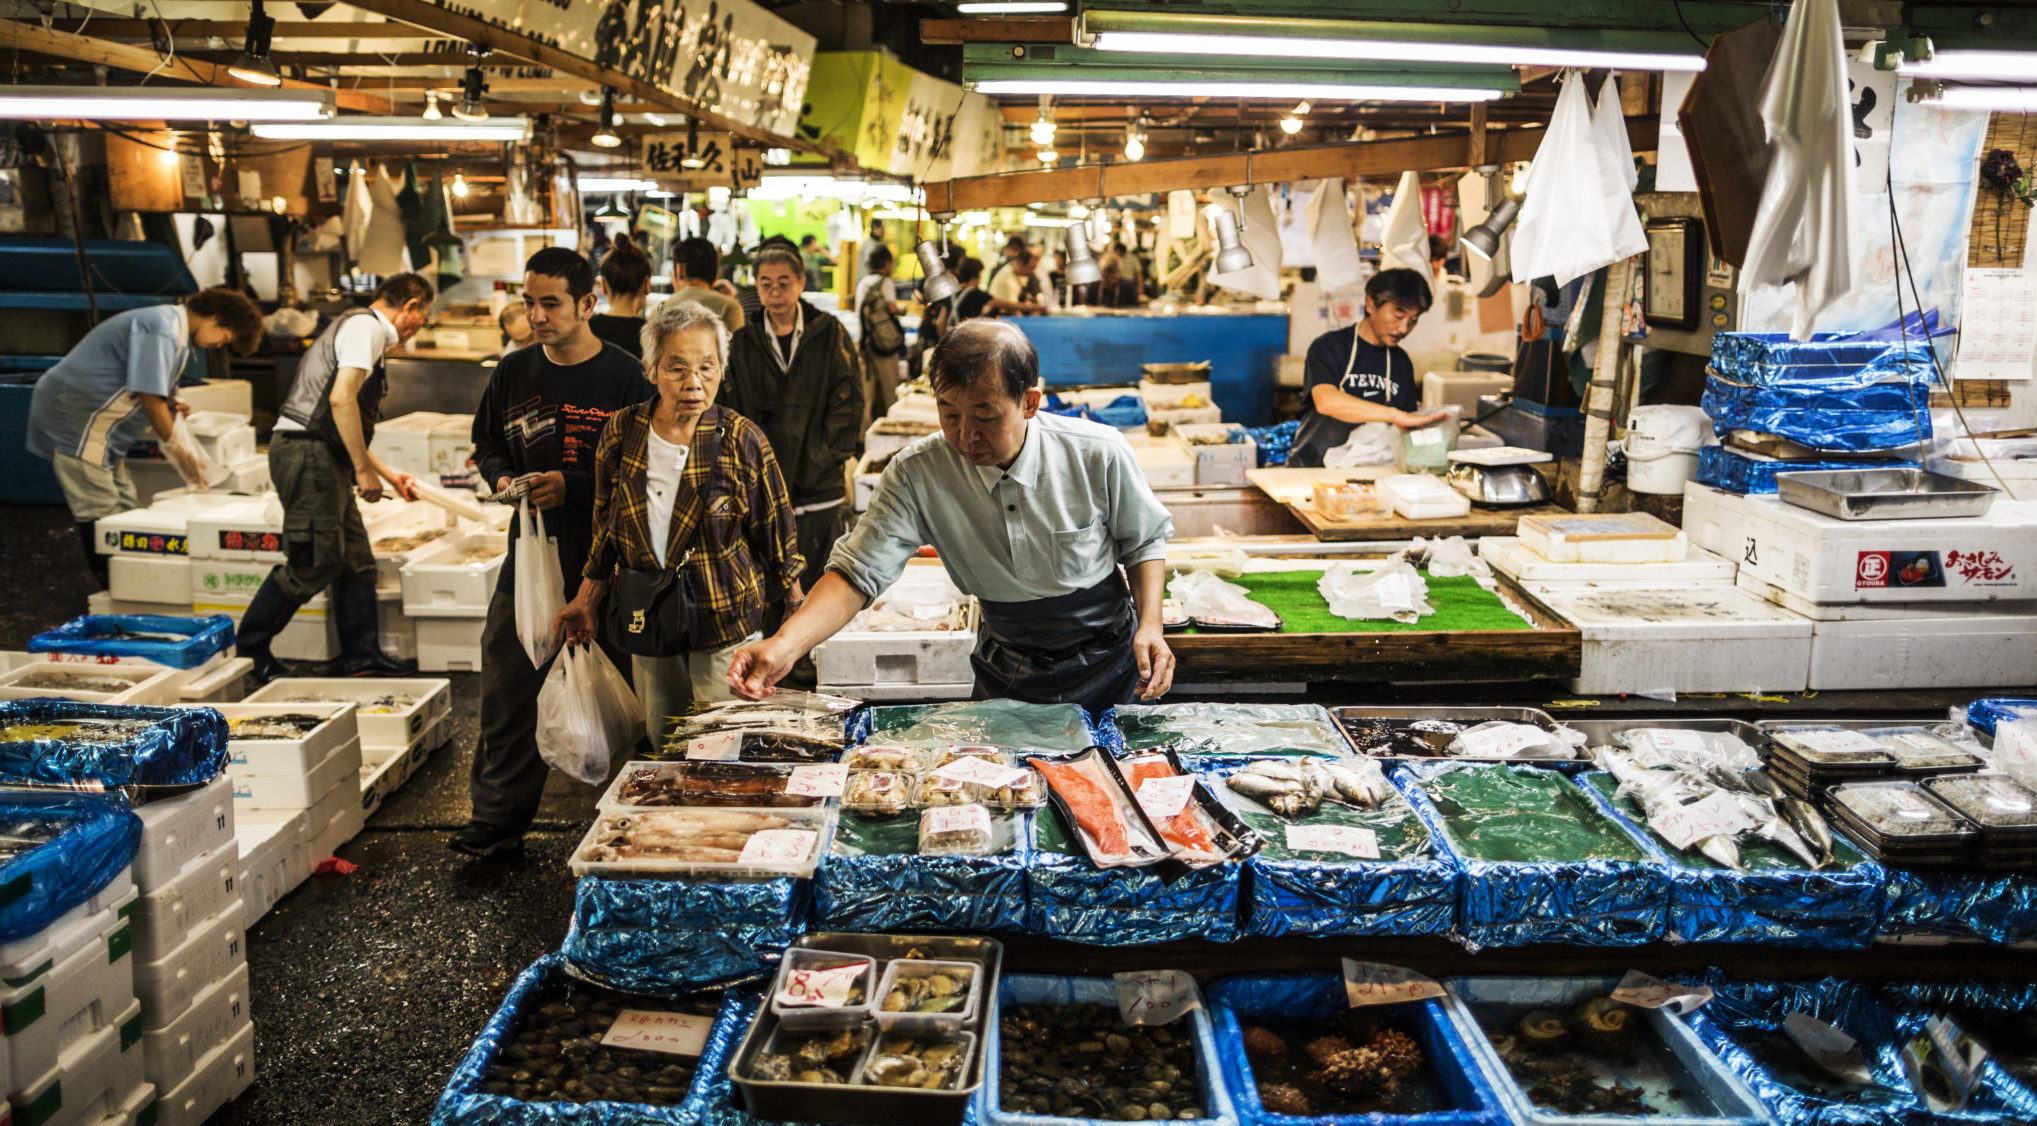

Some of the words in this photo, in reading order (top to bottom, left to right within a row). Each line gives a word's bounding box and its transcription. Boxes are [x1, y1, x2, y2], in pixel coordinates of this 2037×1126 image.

[1346, 373, 1400, 396] TENNS
[1945, 550, 2004, 568] おさしみ
[217, 814, 225, 831] 11
[225, 877, 233, 893] 11
[230, 940, 238, 956] 11
[232, 1002, 240, 1018] 11
[237, 1062, 245, 1079] 11
